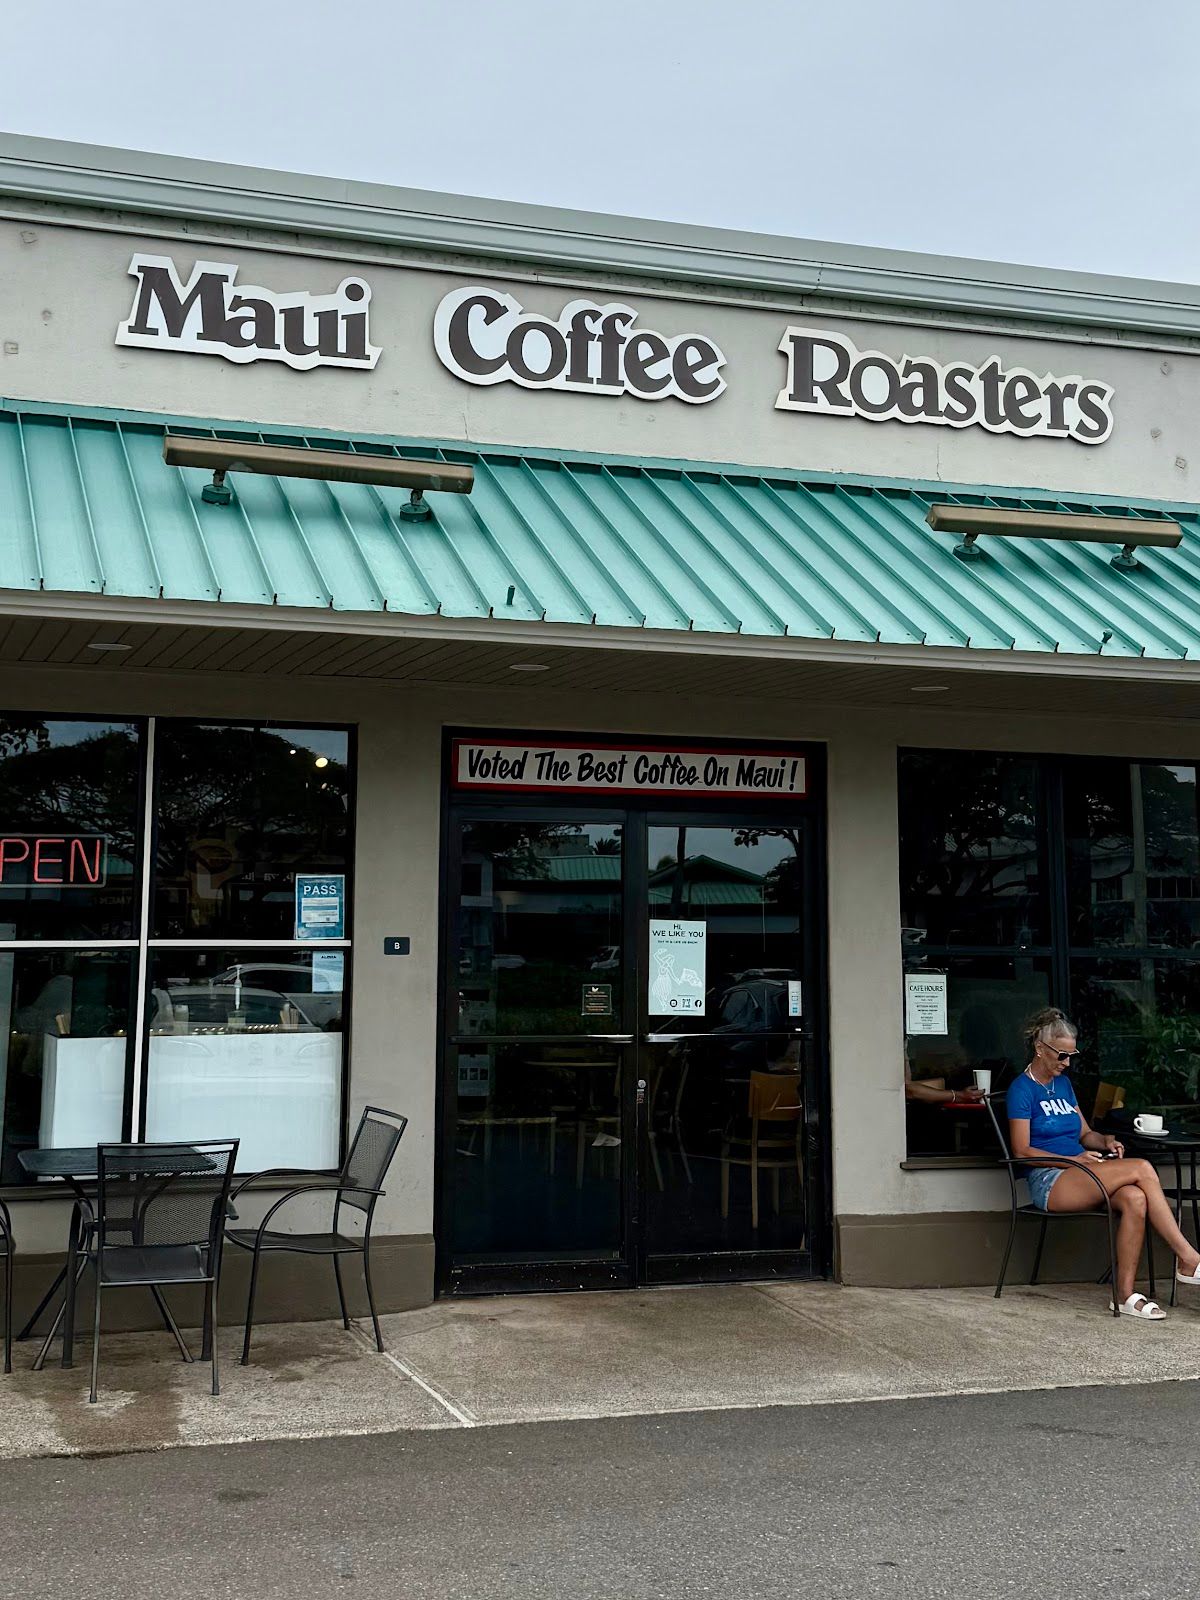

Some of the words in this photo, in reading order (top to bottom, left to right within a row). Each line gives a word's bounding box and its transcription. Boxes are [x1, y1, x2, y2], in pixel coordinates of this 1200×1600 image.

[127, 264, 371, 361] Maui
[447, 294, 722, 397] Coffee
[788, 334, 1109, 438] Roasters
[468, 749, 529, 780] Voted
[535, 750, 572, 782] The
[577, 752, 628, 783] Best
[633, 754, 699, 785] Coffee
[703, 756, 729, 786] On
[303, 885, 337, 895] PASS
[394, 942, 400, 950] B
[1039, 1098, 1078, 1117] PAIA
